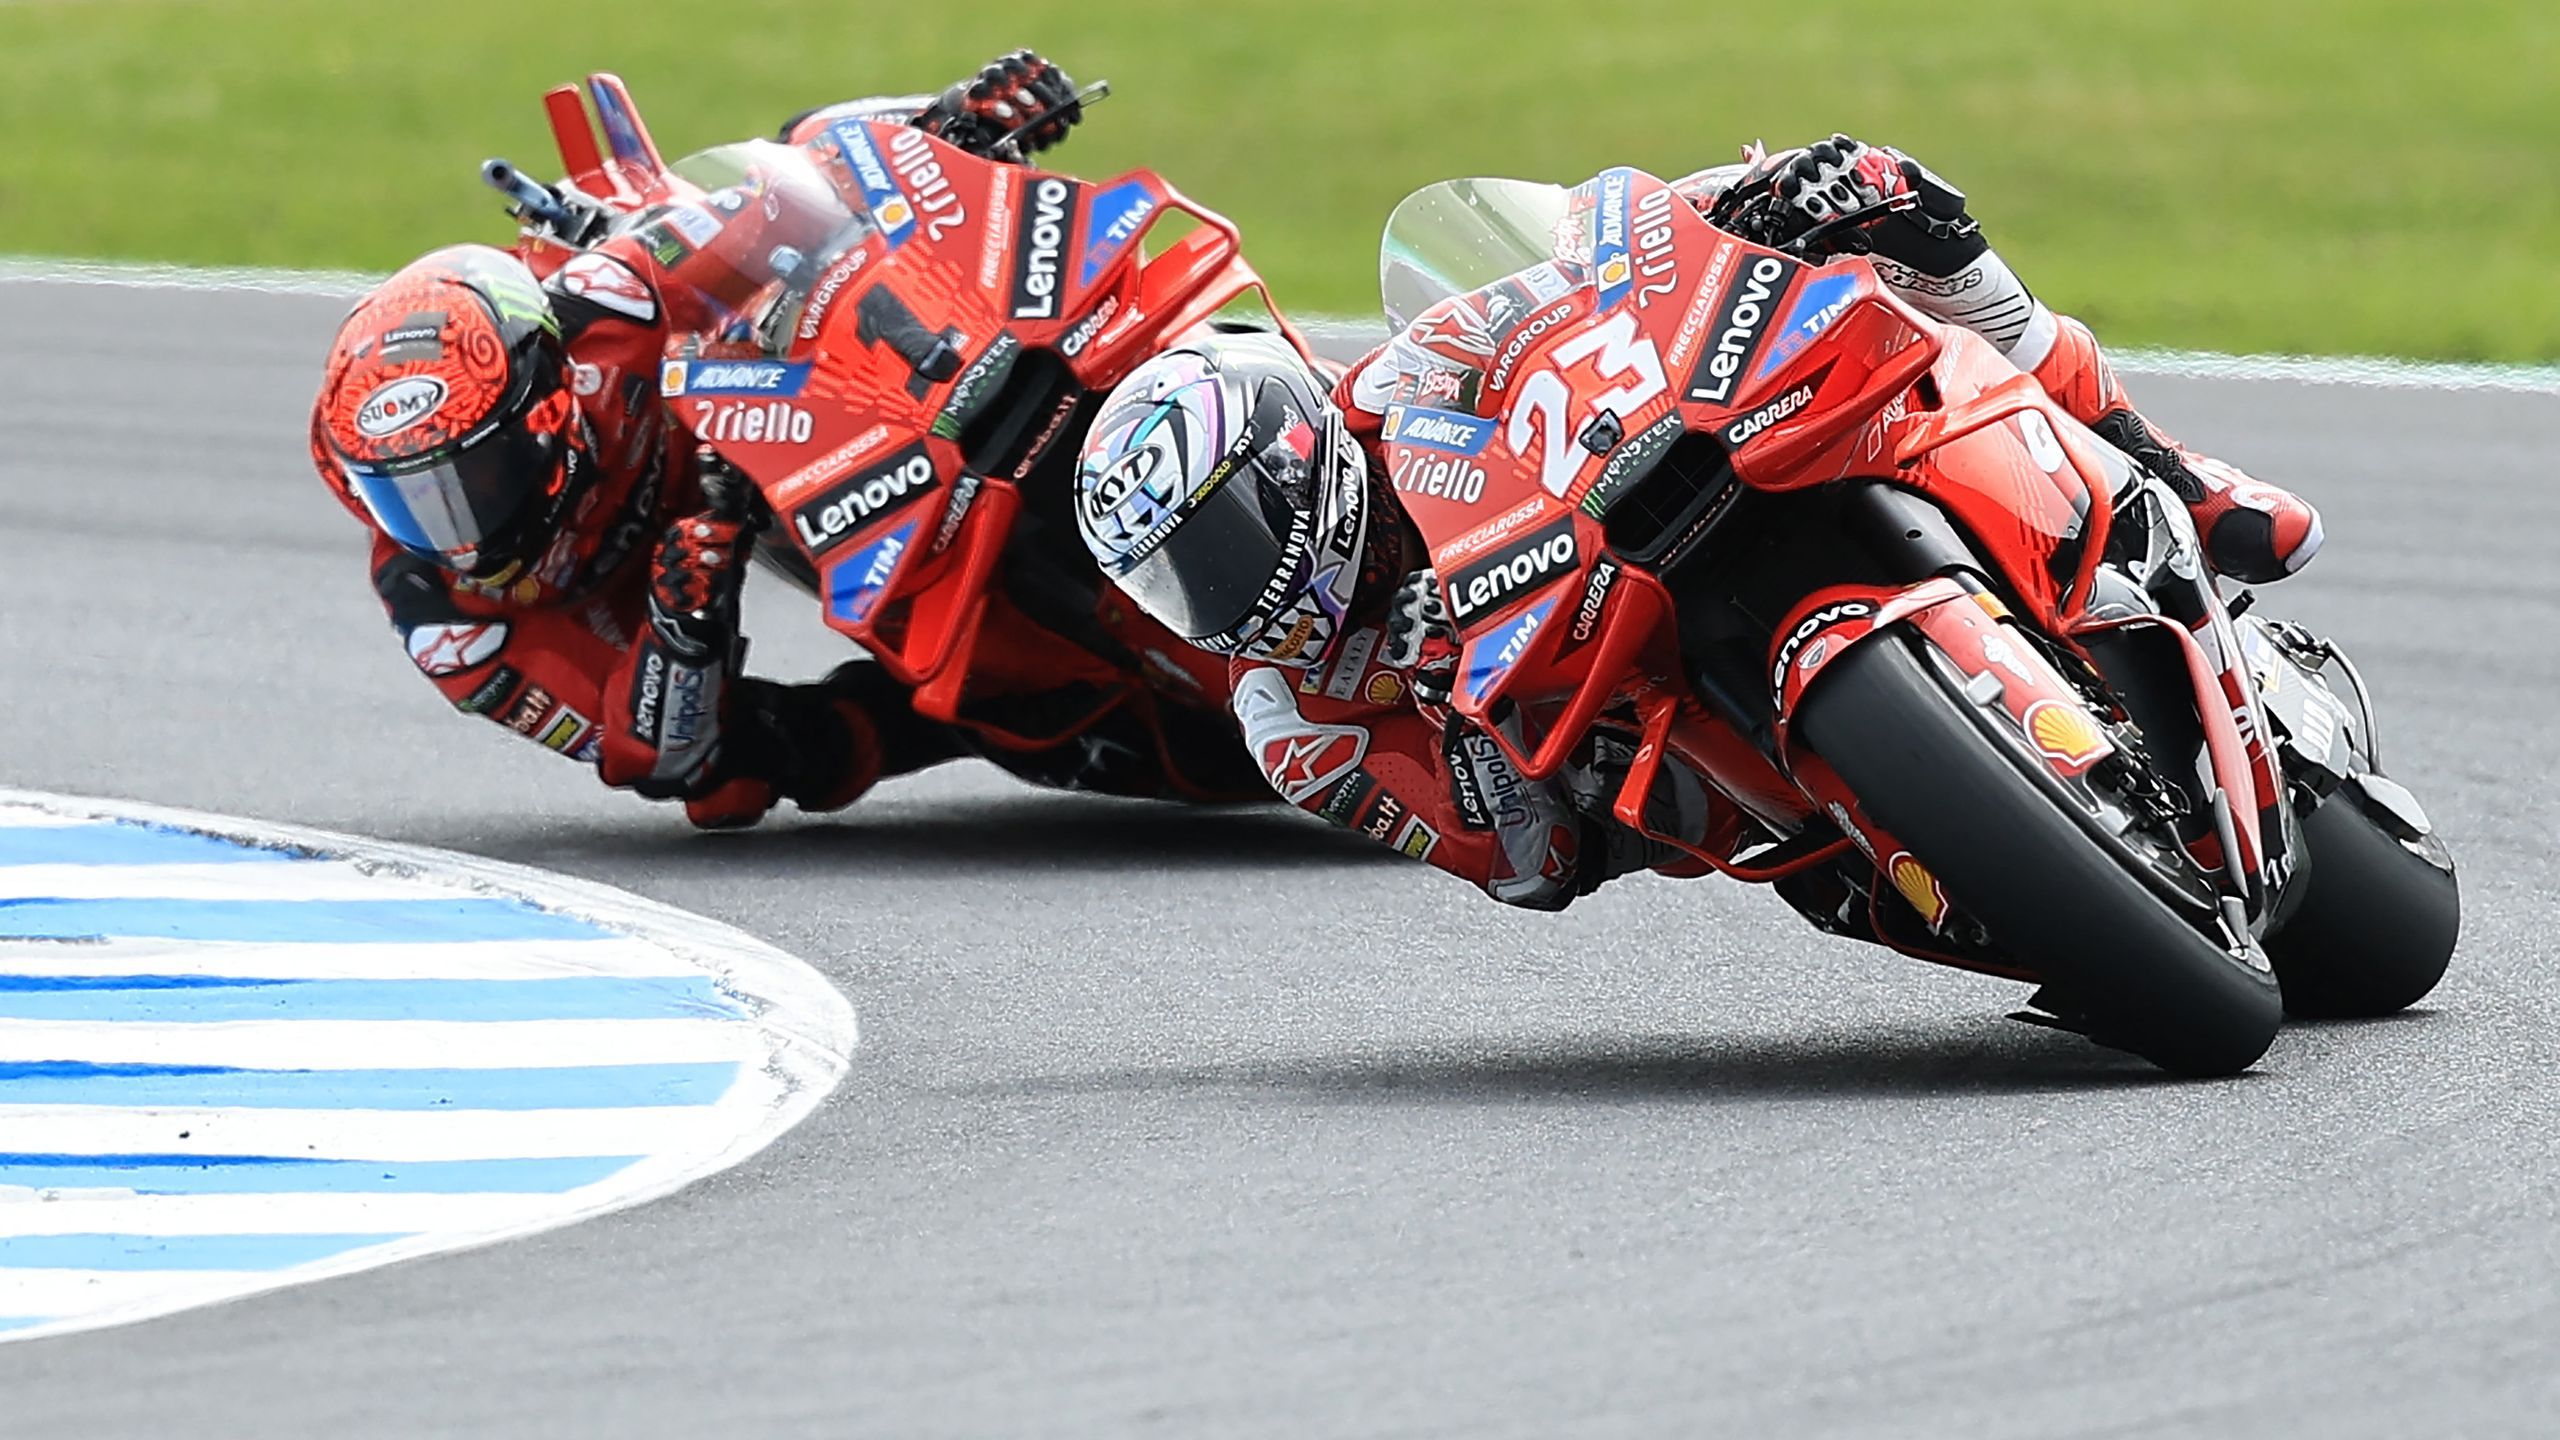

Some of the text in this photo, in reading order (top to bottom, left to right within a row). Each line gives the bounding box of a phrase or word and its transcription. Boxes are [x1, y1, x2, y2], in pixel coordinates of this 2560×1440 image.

[1107, 199, 1154, 240] TIM
[1599, 174, 1625, 246] ADVANCE
[1015, 179, 1068, 318] Lenovo
[1669, 242, 1735, 367] FRECCIAROSSA
[1692, 258, 1783, 401] Lenovo
[1803, 293, 1853, 335] TIM
[692, 366, 786, 389] ADVANCE
[1490, 304, 1572, 392] VARGROUP
[360, 389, 435, 424] SUOMY
[1403, 415, 1477, 447] ADVANCE
[1506, 311, 1668, 498] 23
[1728, 385, 1814, 445] CARRERA
[1097, 456, 1142, 512] KYT
[1596, 415, 1681, 493] MONSTER
[796, 456, 932, 547] Lenovo
[1129, 513, 1183, 559] TERRANOVA
[1337, 467, 1358, 549] Lenovo
[1438, 497, 1545, 563] FRECCIAROSSA
[865, 537, 904, 586] TIM
[1258, 509, 1310, 611] TERRANOVA
[1449, 533, 1574, 618] Lenovo
[1498, 612, 1540, 663] TIM
[1573, 562, 1616, 641] CARRERA
[1335, 633, 1367, 696] EATALY
[1770, 602, 1870, 712] Lenovo
[1363, 795, 1401, 840] ba.it
[1450, 745, 1486, 825] Lenov
